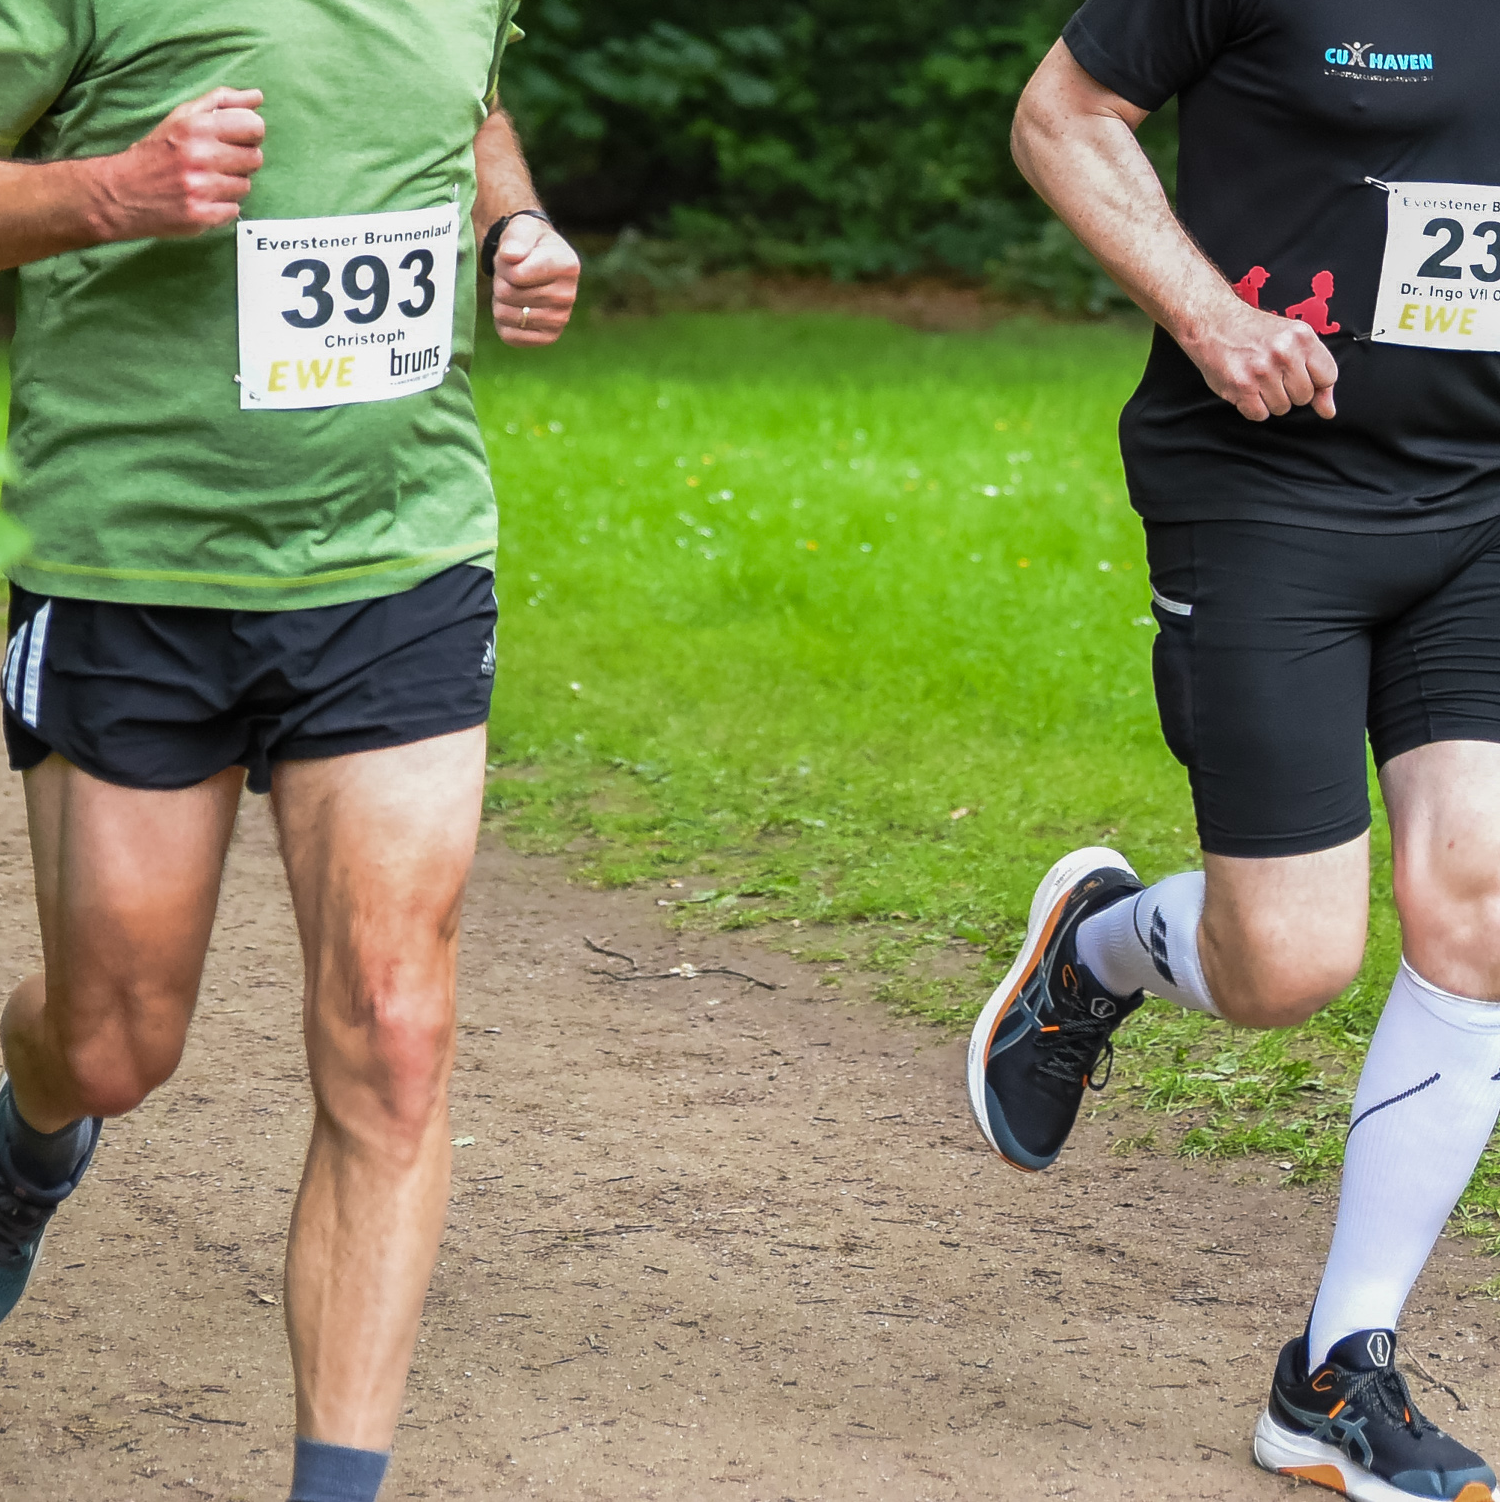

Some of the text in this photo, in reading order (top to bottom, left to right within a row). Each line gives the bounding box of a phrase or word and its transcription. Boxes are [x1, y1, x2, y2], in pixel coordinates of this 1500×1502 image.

[1403, 196, 1487, 212] Everstener
[256, 221, 452, 251] Everstener Brunnenlauf
[280, 248, 436, 329] 393
[1400, 283, 1423, 296] Dr.
[1429, 285, 1463, 302] Ingo
[1397, 303, 1478, 336] EWE
[324, 329, 406, 348] Christoph
[267, 356, 356, 392] EWE
[390, 345, 440, 376] bruns
